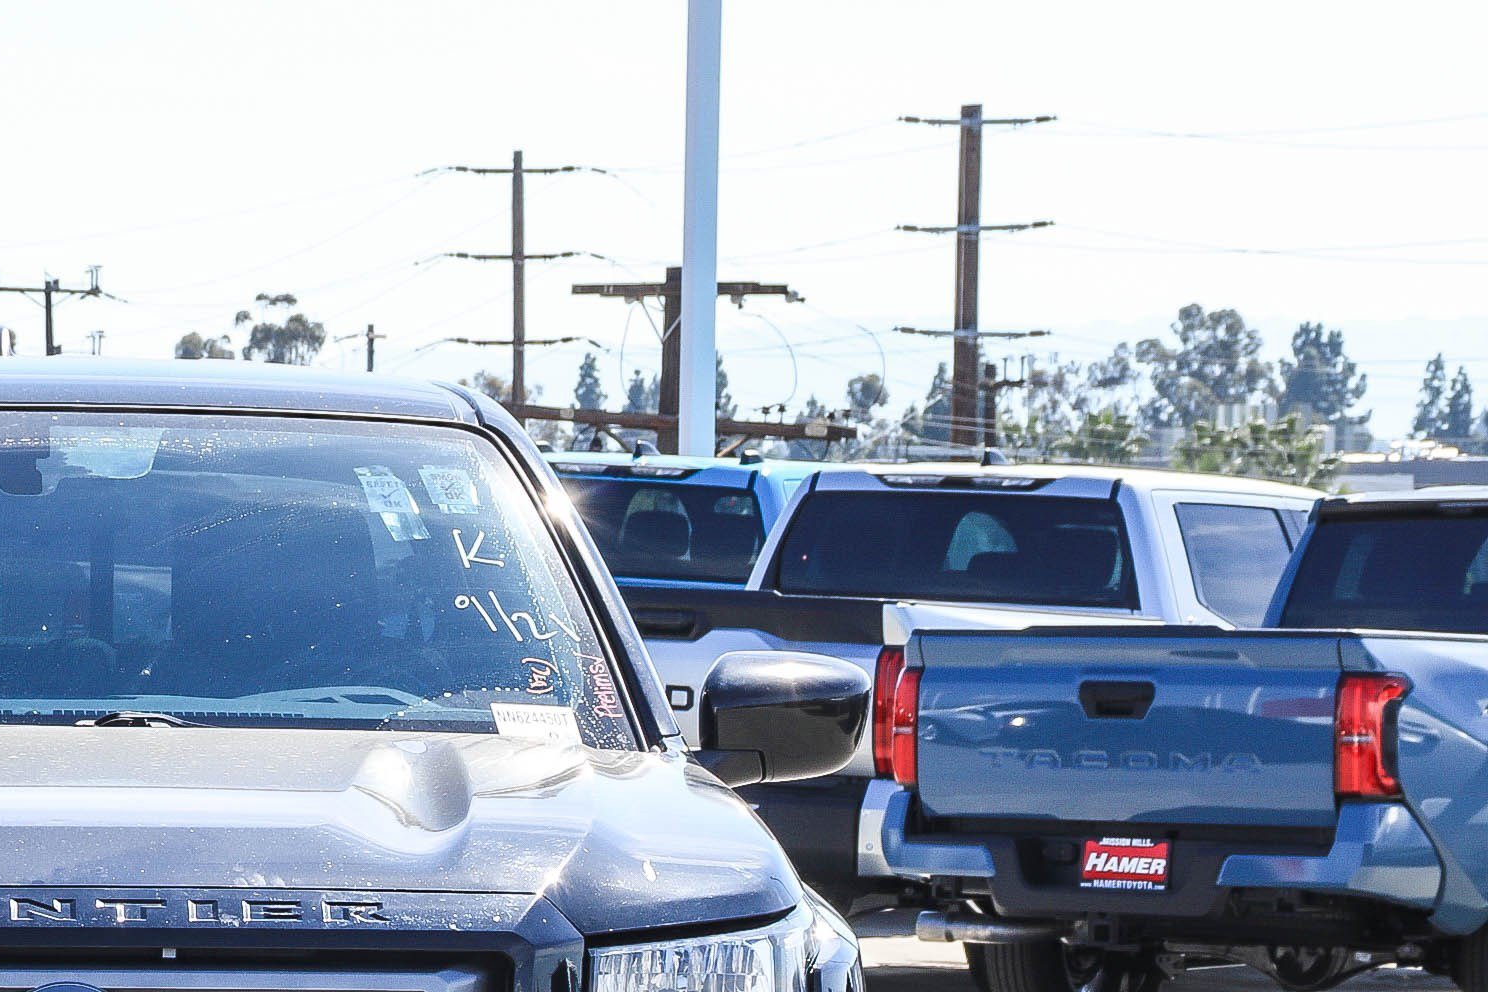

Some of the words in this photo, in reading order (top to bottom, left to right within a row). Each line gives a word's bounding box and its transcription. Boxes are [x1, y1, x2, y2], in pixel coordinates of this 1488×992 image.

[452, 528, 505, 569] K
[979, 748, 1262, 772] TACOMA
[1084, 852, 1167, 875] HAMER
